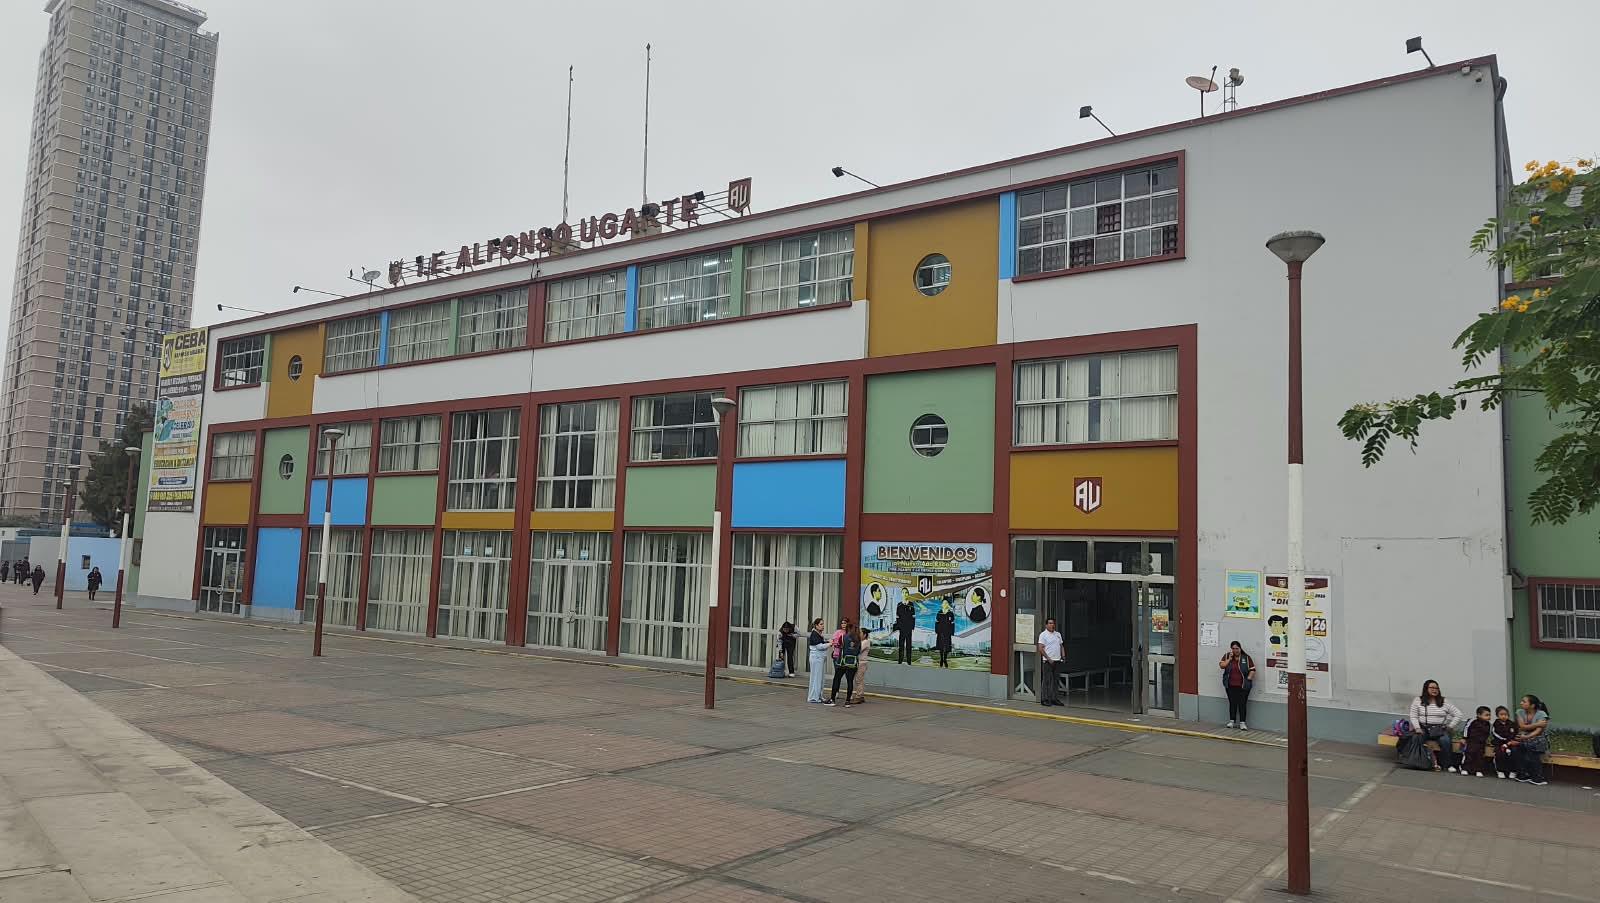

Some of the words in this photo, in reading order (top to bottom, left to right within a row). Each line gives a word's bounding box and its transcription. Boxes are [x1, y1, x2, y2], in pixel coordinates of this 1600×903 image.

[730, 184, 749, 209] AU
[456, 222, 572, 270] ALFONSO
[580, 195, 699, 243] UGARTE
[176, 329, 206, 350] CEBA
[1076, 480, 1100, 512] AU
[877, 545, 977, 562] BIENVENIDOS
